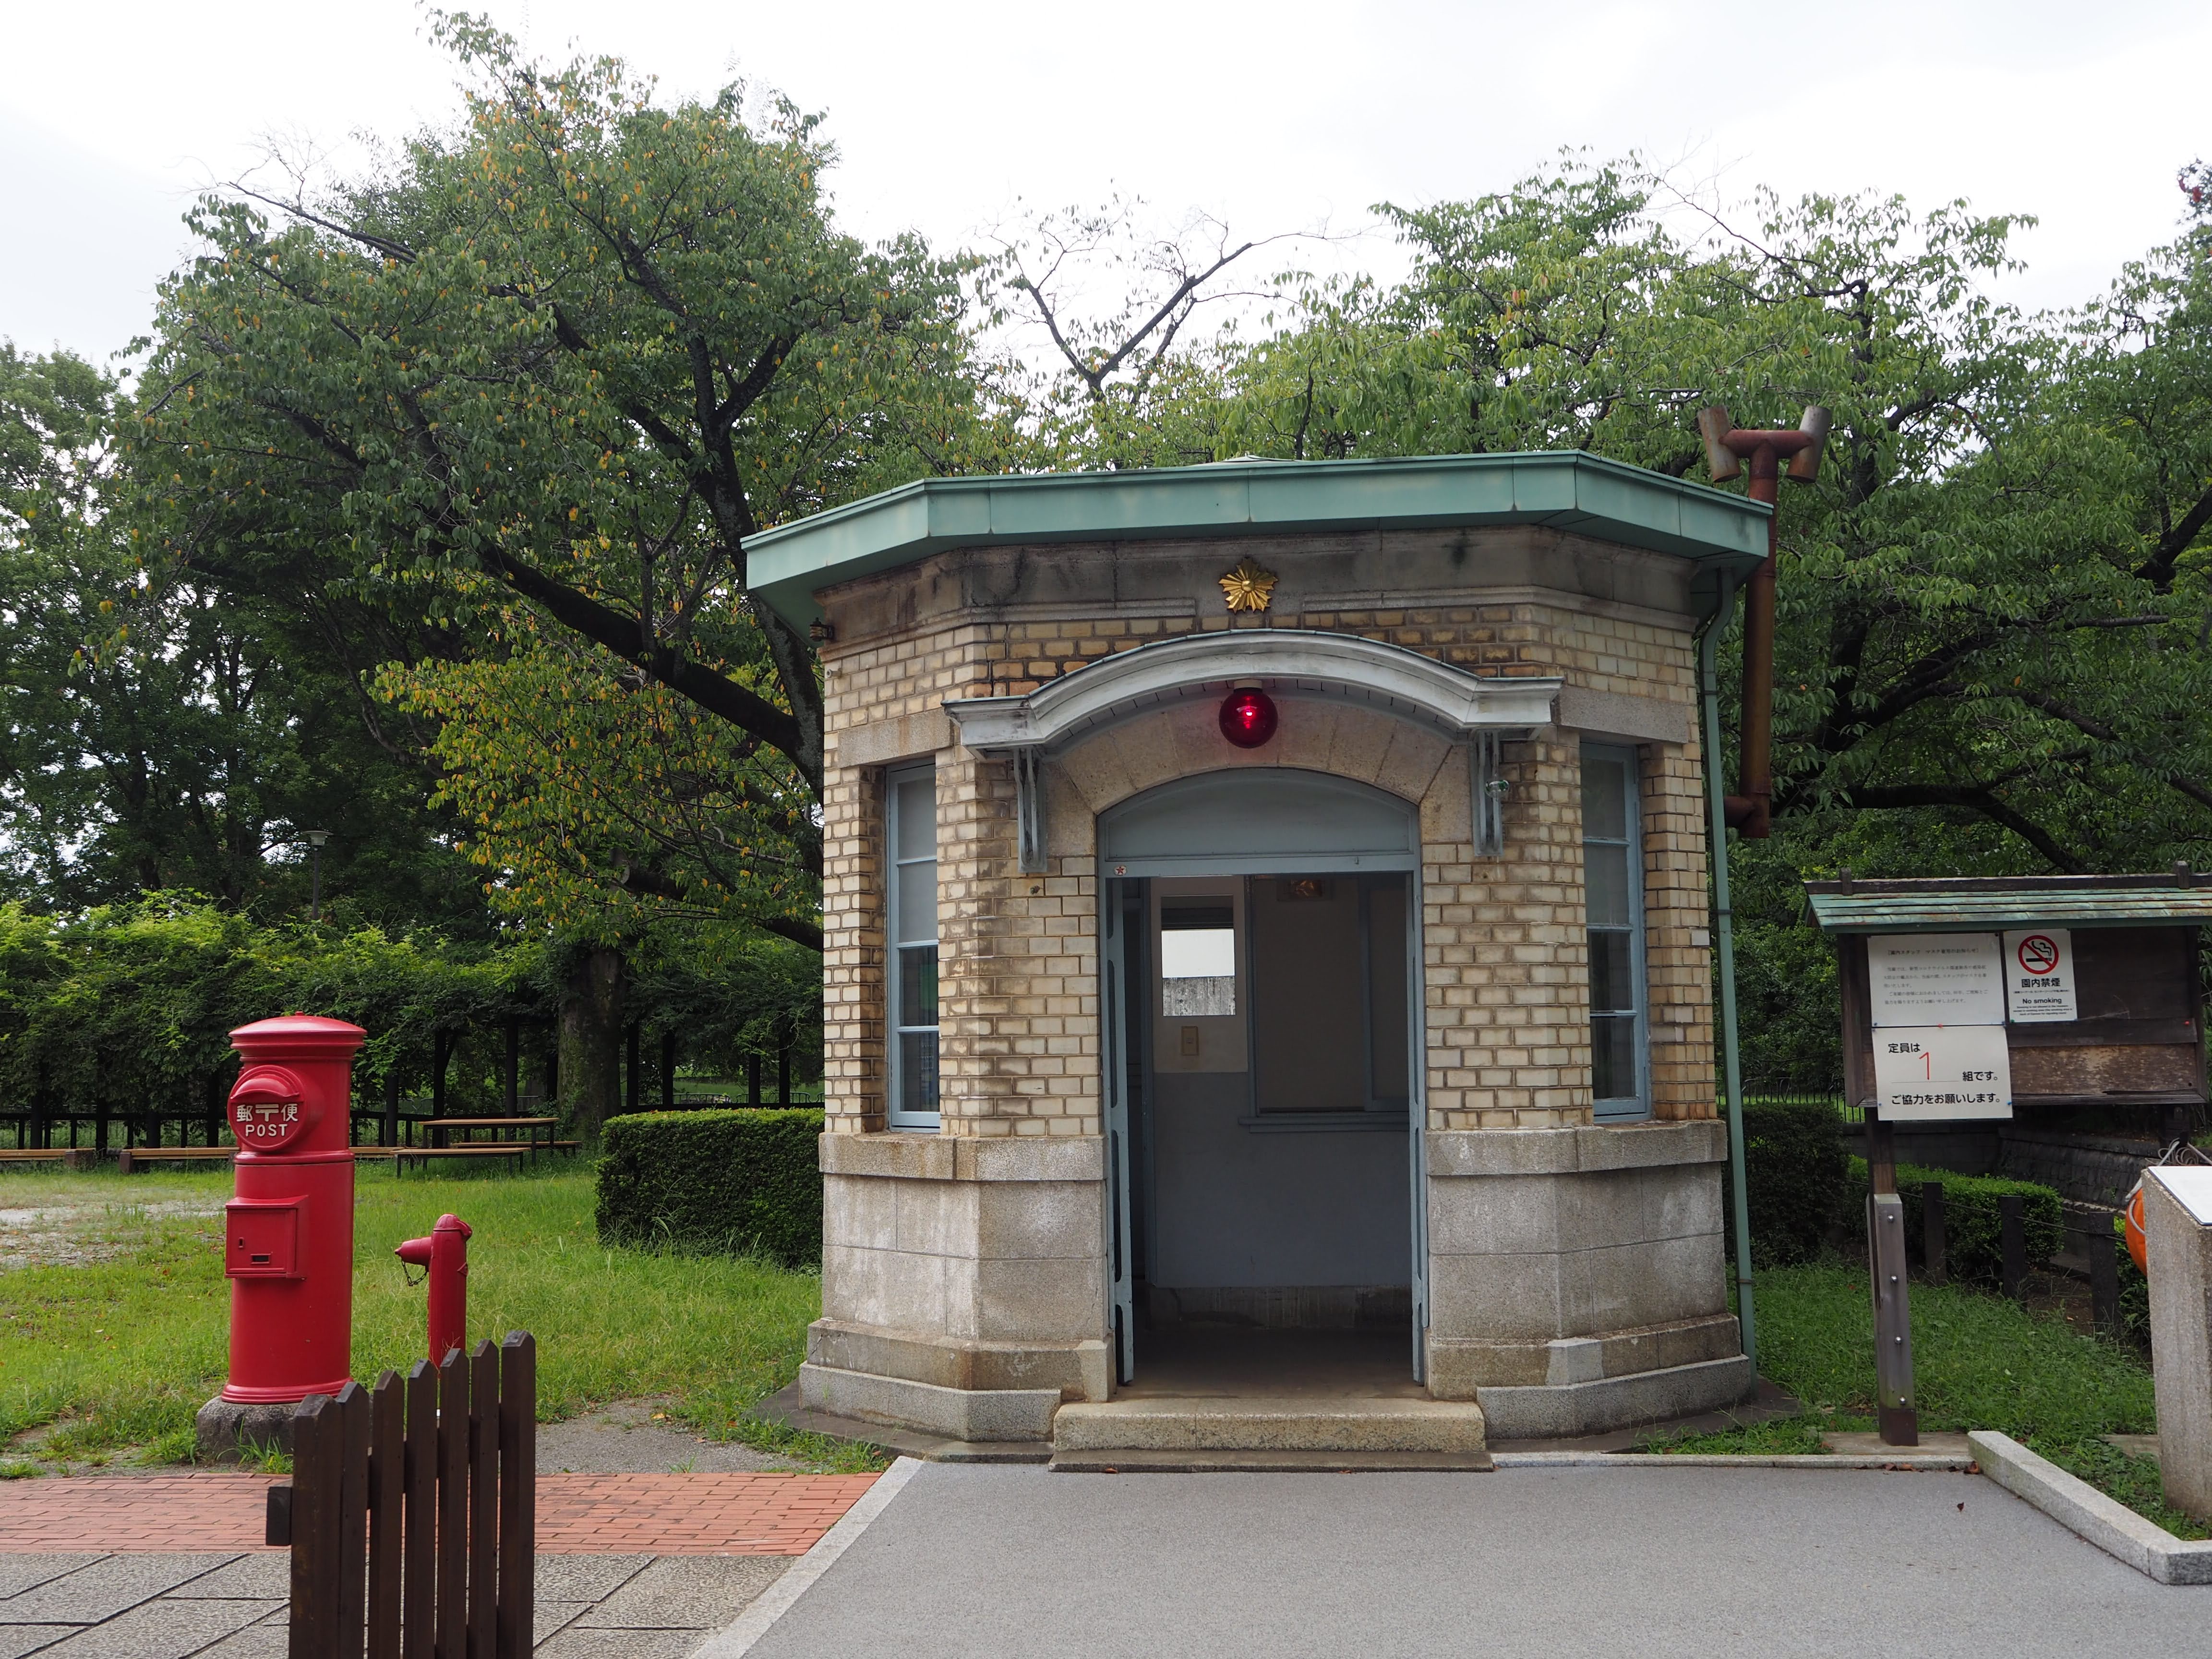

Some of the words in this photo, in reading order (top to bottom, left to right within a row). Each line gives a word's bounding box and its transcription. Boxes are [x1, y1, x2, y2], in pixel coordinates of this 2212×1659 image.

[2021, 978, 2060, 987] 園内禁煙
[1888, 1043, 1920, 1053] 定員は
[1919, 1052, 1929, 1080] 1
[1962, 1071, 1998, 1081] 組です。
[1892, 1093, 2000, 1105] ご協力をお願いします。
[245, 1124, 288, 1137] POST
